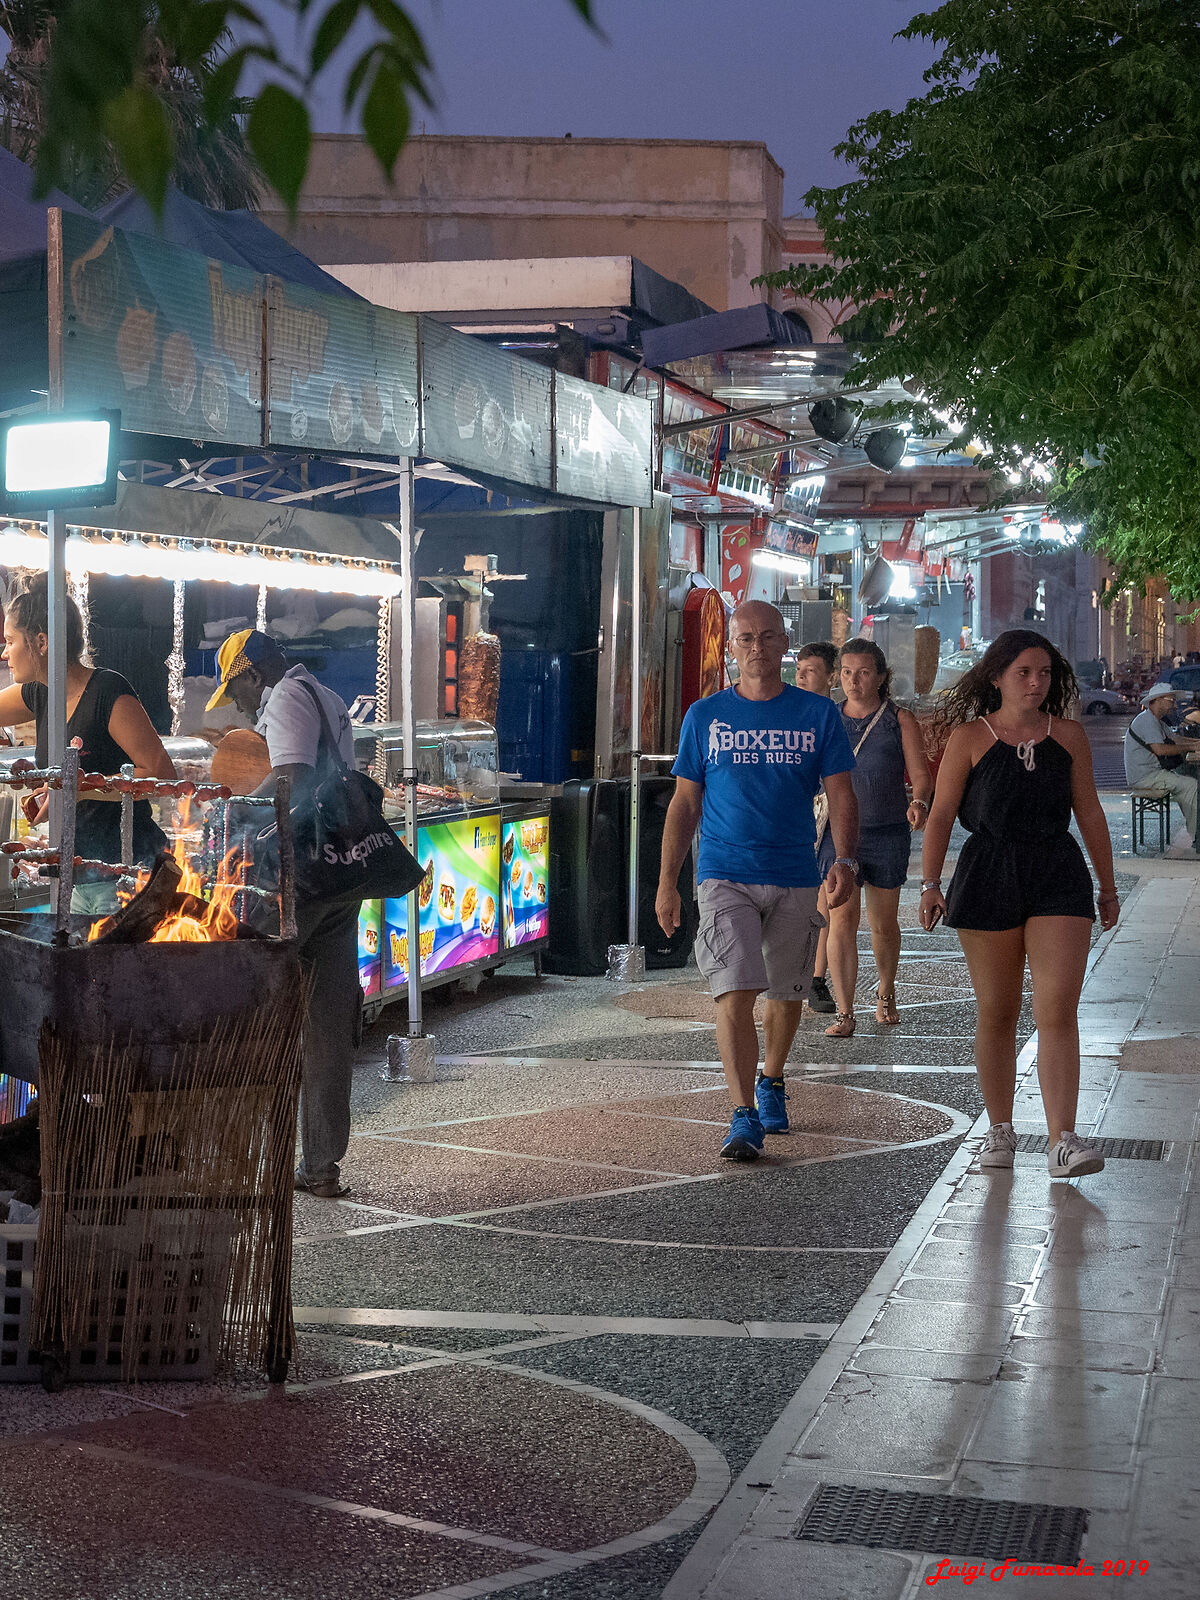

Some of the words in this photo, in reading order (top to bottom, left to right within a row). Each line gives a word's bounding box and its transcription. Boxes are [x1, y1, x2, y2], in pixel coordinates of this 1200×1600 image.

[720, 729, 816, 753] BOXEUR
[732, 752, 759, 764] DES
[766, 752, 802, 765] RUES
